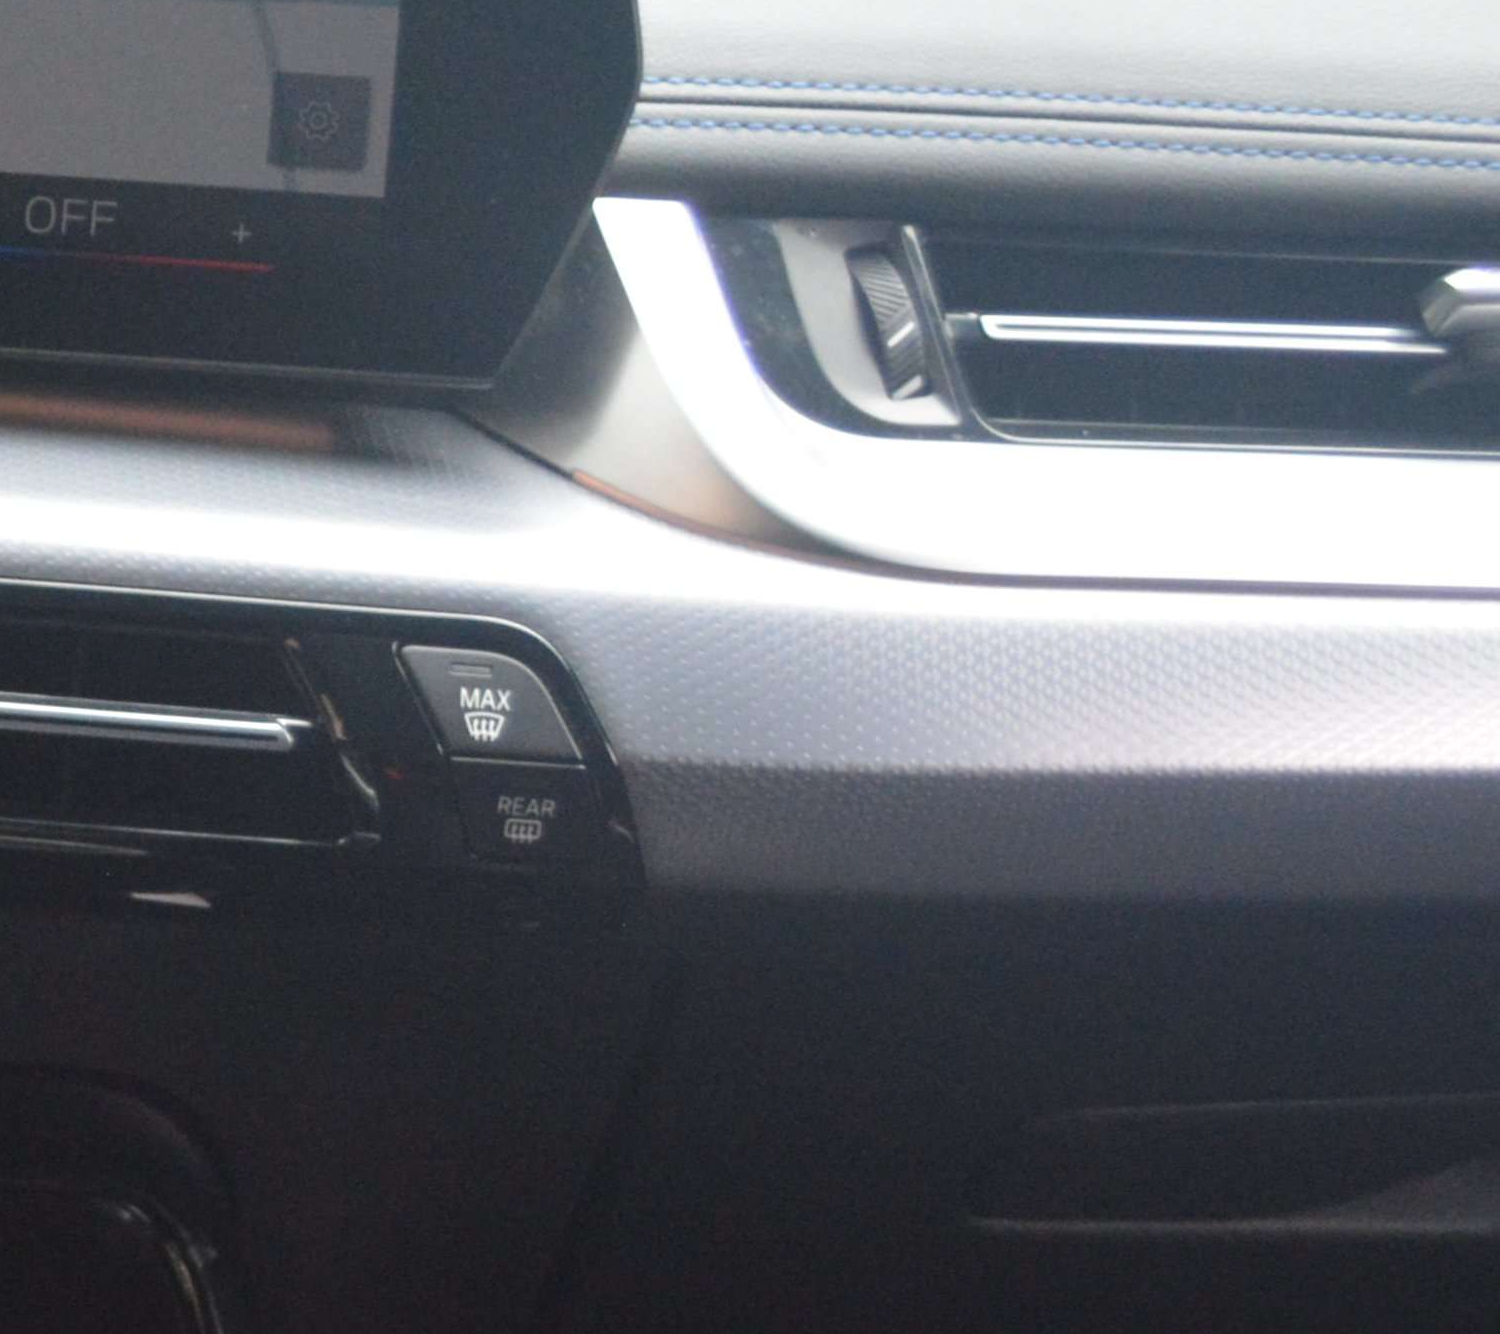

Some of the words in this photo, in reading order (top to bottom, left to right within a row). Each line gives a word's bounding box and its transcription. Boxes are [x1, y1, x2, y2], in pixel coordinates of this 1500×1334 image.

[24, 194, 119, 237] OFF
[459, 686, 512, 712] MAX
[497, 794, 557, 817] REAR
